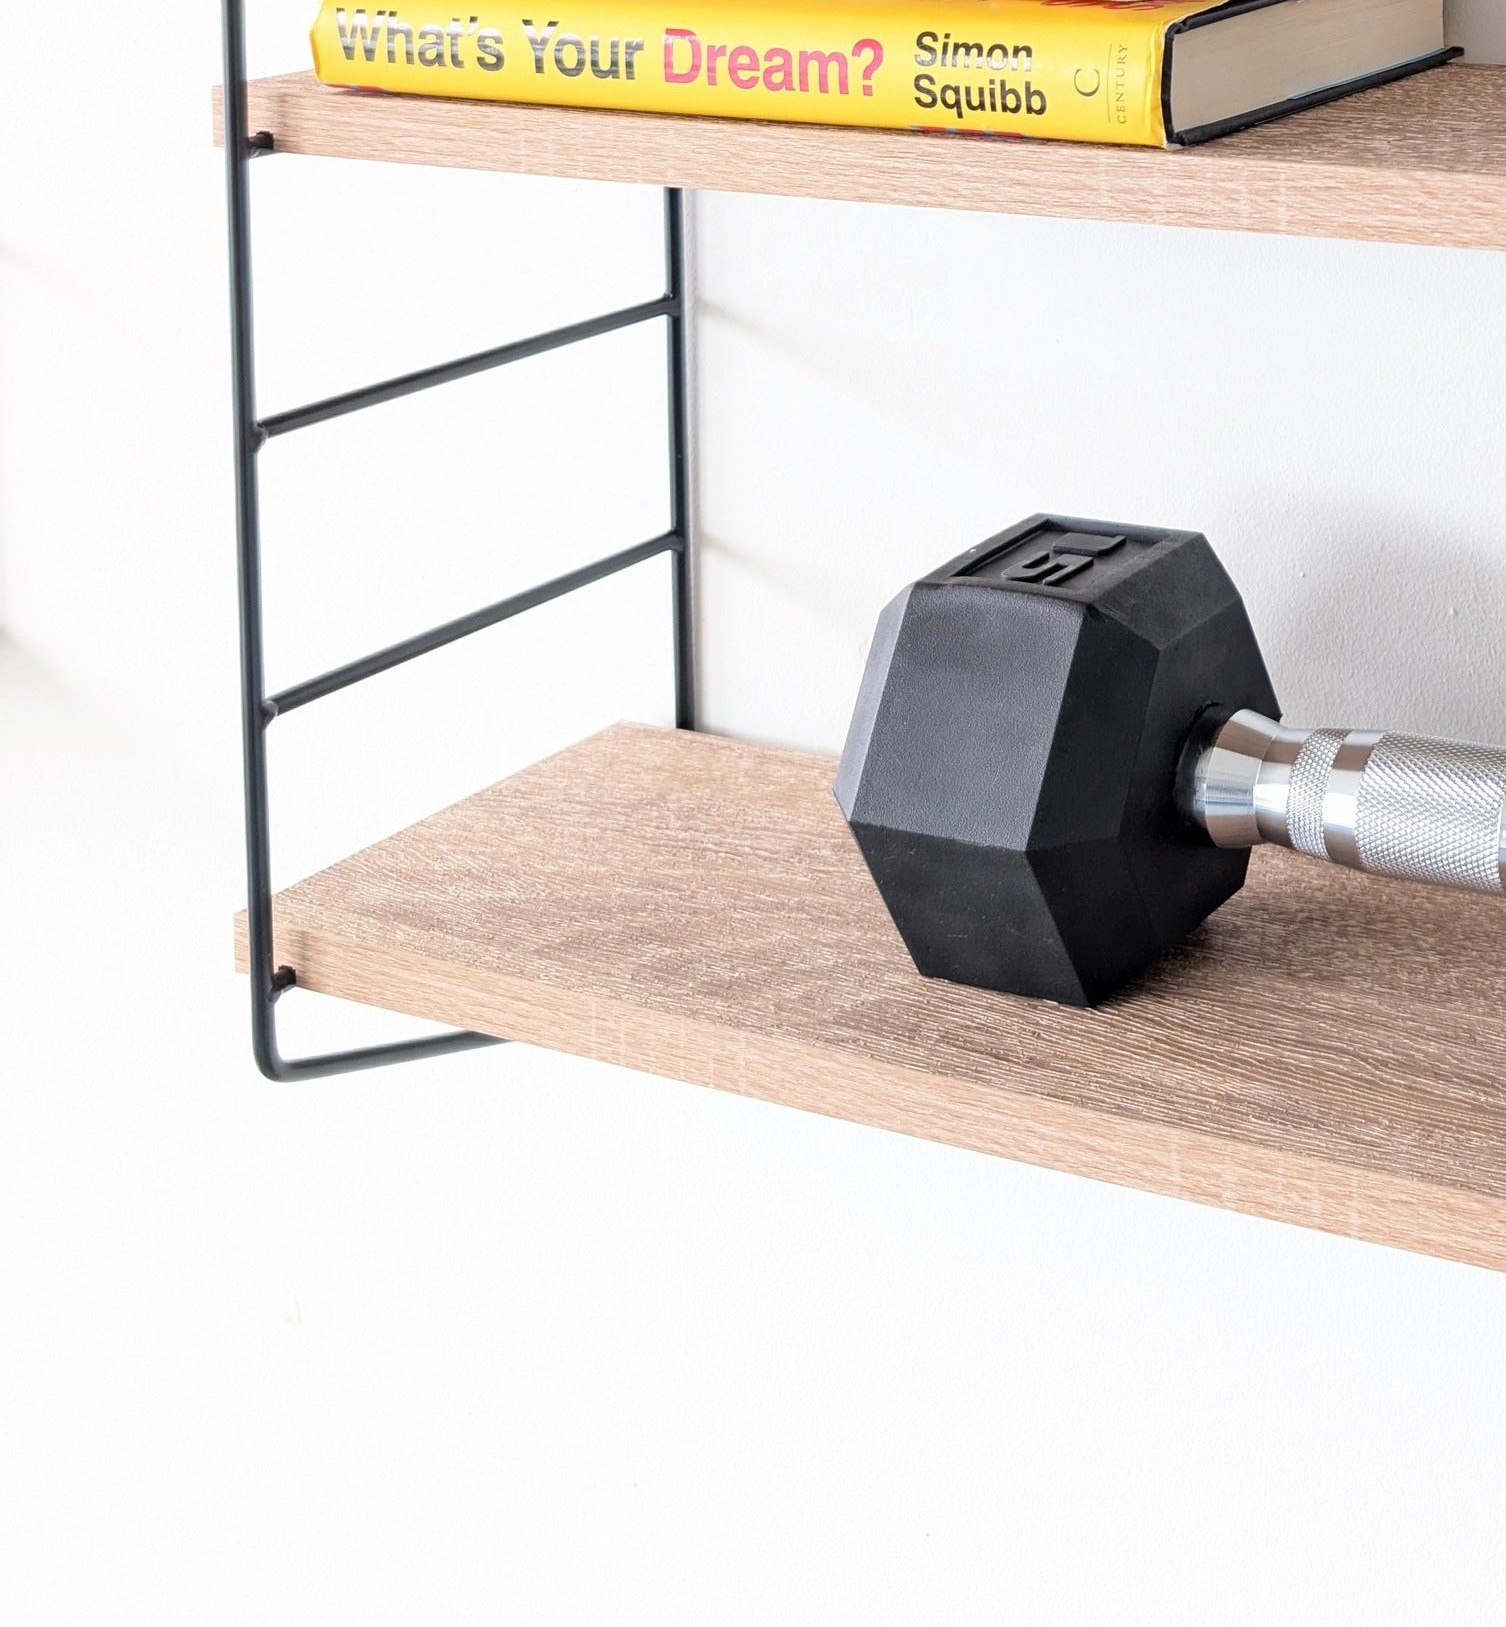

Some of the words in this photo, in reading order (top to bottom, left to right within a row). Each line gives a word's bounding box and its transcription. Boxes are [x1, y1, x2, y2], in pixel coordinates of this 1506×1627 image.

[336, 6, 505, 72] What's
[522, 18, 645, 81] Your
[663, 27, 885, 97] Dream?
[914, 30, 1033, 72] Simon
[914, 73, 1048, 119] Squibb
[1115, 43, 1128, 125] CENTURY
